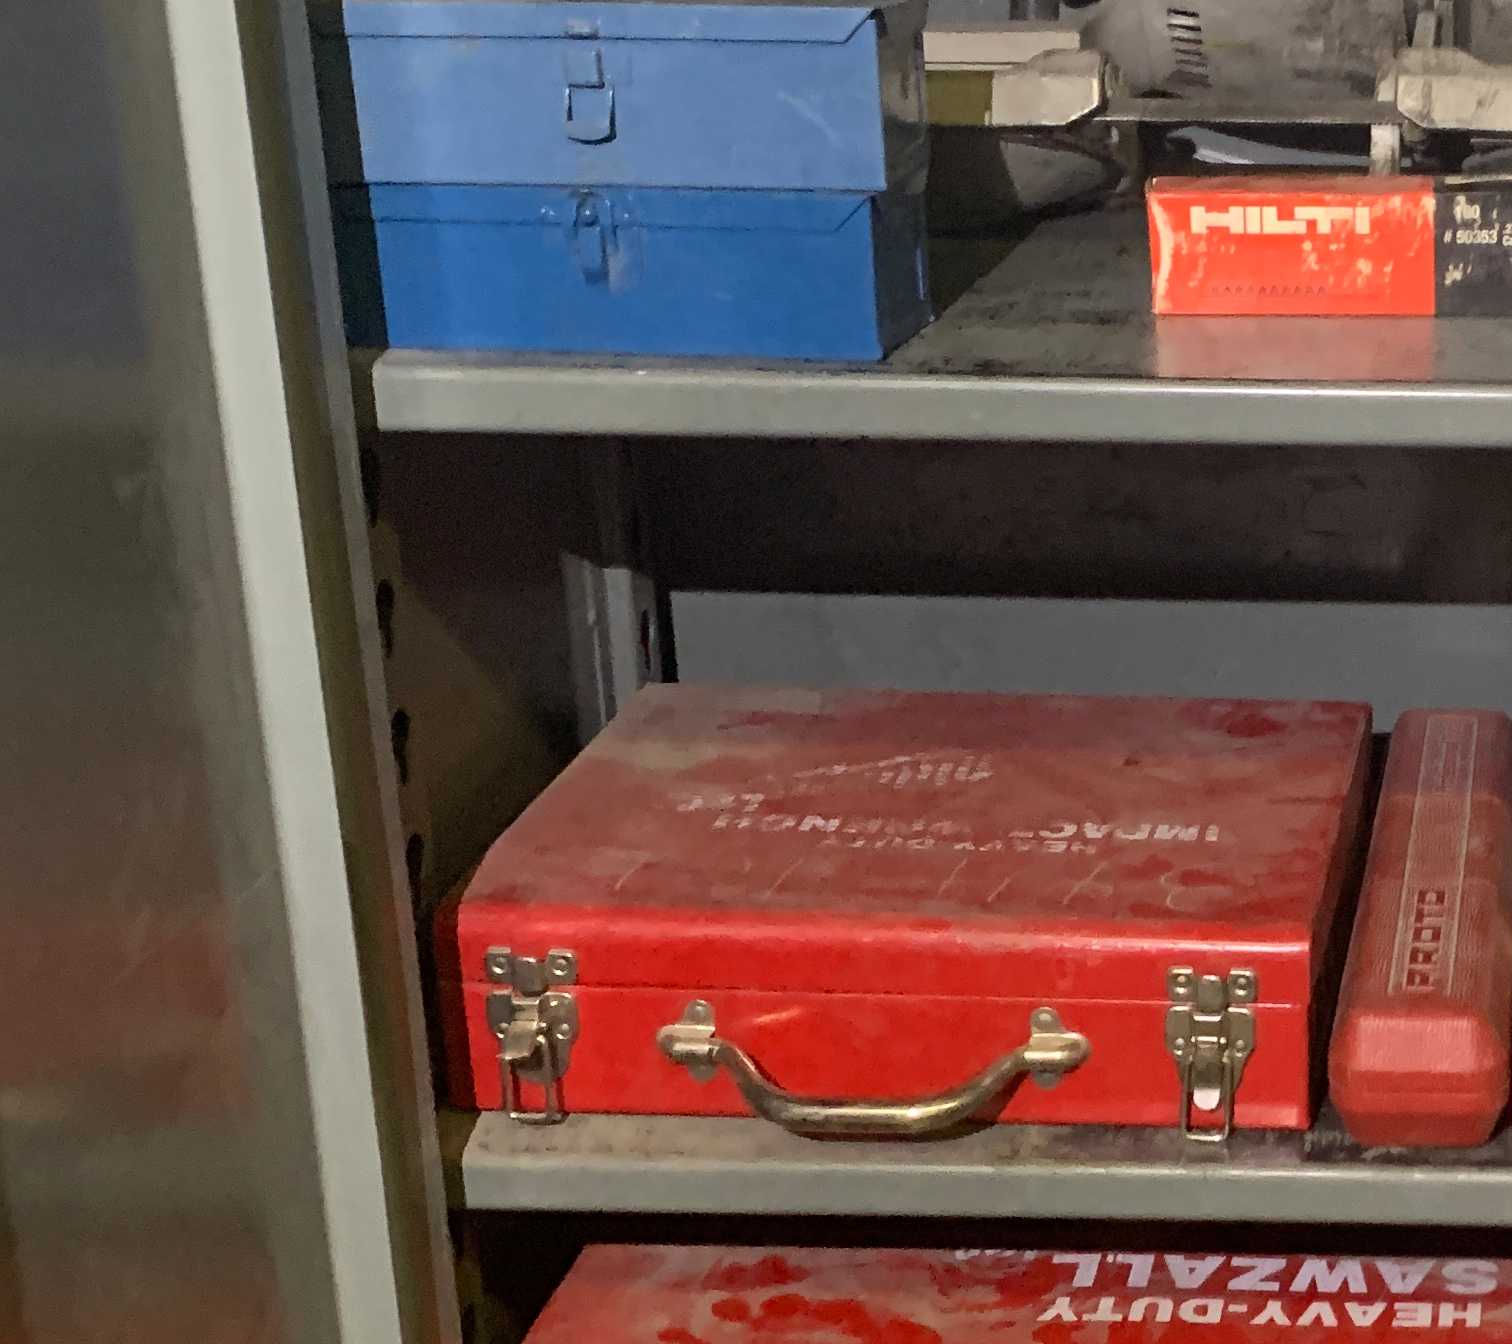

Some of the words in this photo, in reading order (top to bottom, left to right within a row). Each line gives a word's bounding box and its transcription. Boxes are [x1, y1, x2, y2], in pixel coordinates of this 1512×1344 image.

[1190, 205, 1371, 235] HILTI
[1402, 890, 1448, 992] PROTO
[1050, 1253, 1501, 1296] SAWZALL
[1036, 1295, 1482, 1328] HEAVY-DUTY
